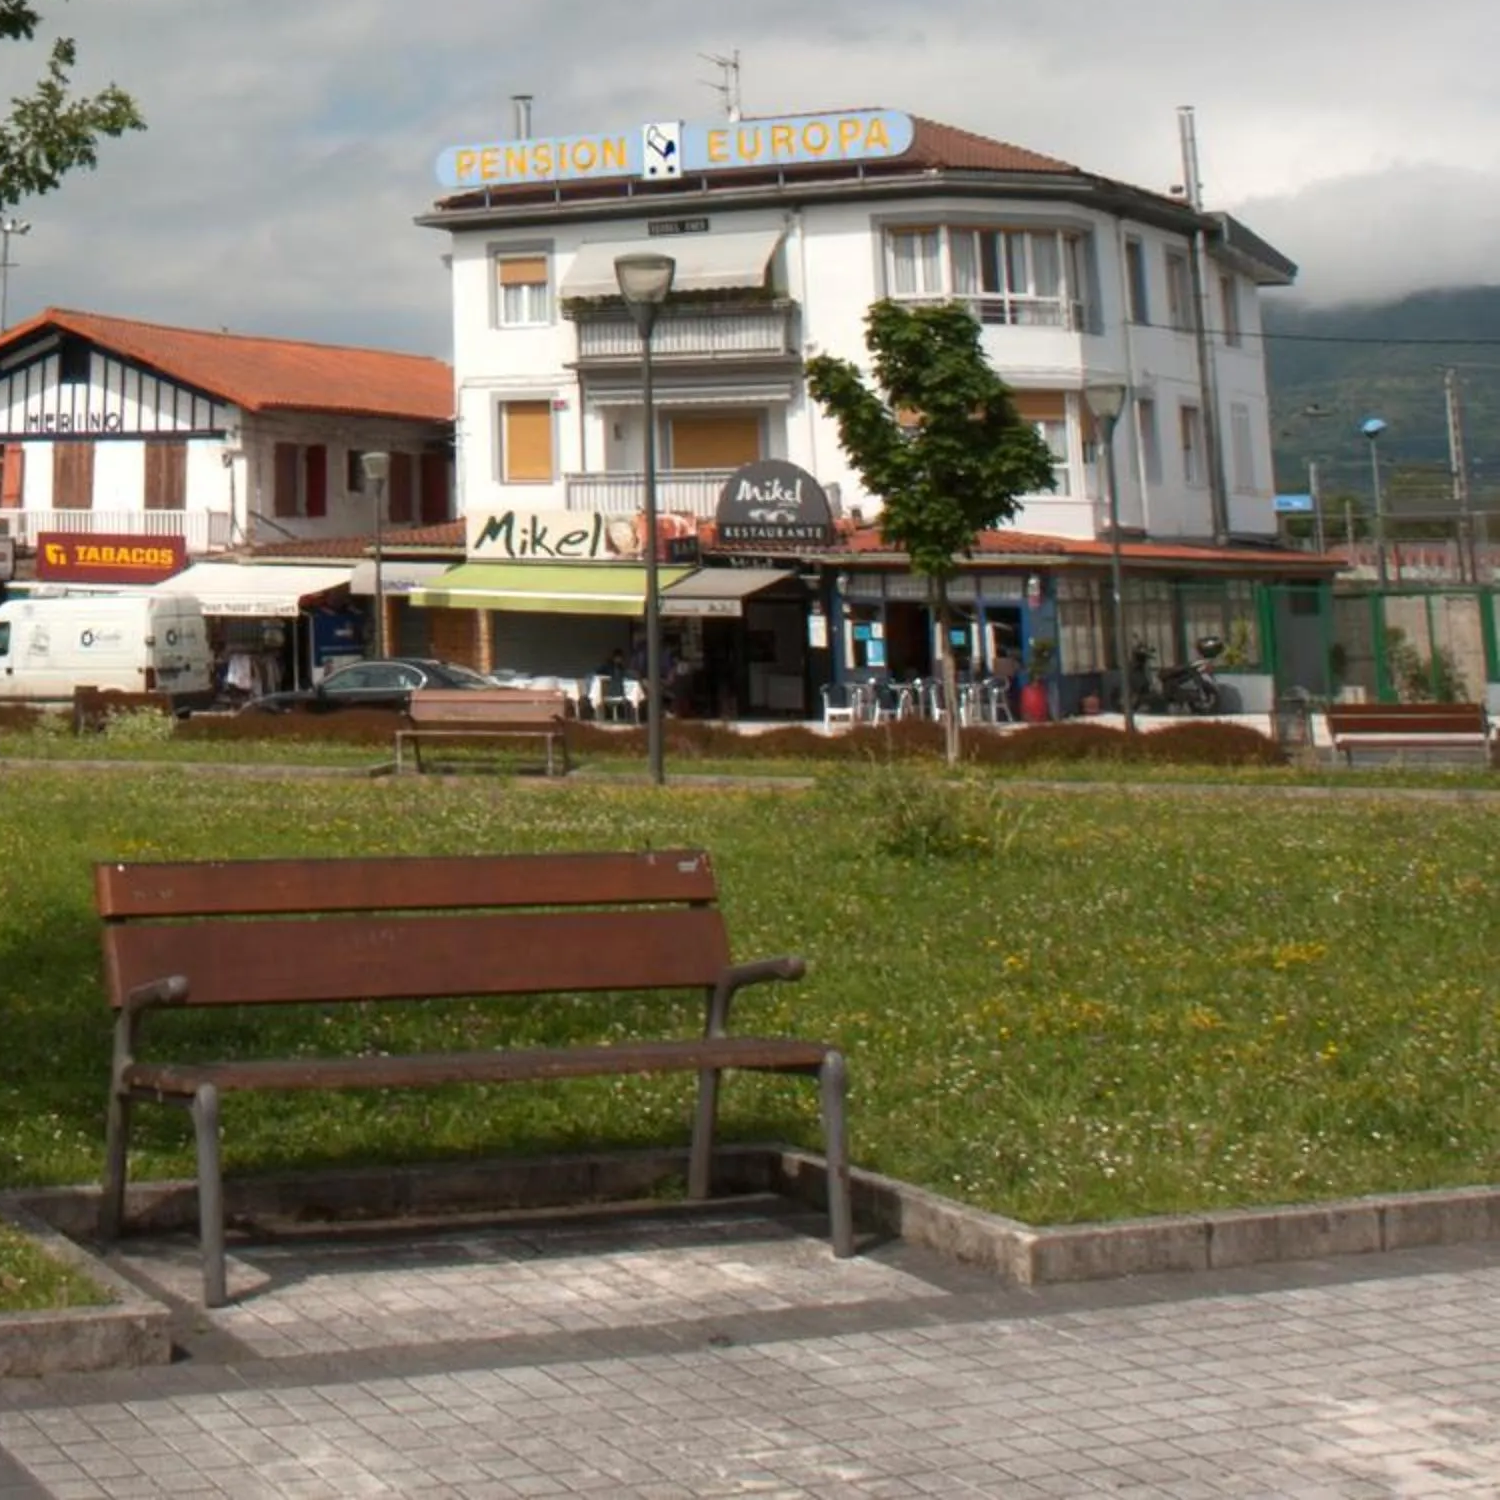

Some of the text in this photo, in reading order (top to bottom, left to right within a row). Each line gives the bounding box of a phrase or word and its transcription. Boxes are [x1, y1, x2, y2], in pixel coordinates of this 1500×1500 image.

[456, 117, 890, 181] PENSION EUROPA
[29, 411, 123, 433] MERINO
[736, 477, 803, 504] Mikel
[474, 510, 601, 559] Mikel
[724, 526, 822, 539] RESTAURANTE
[74, 545, 174, 565] TABACOS
